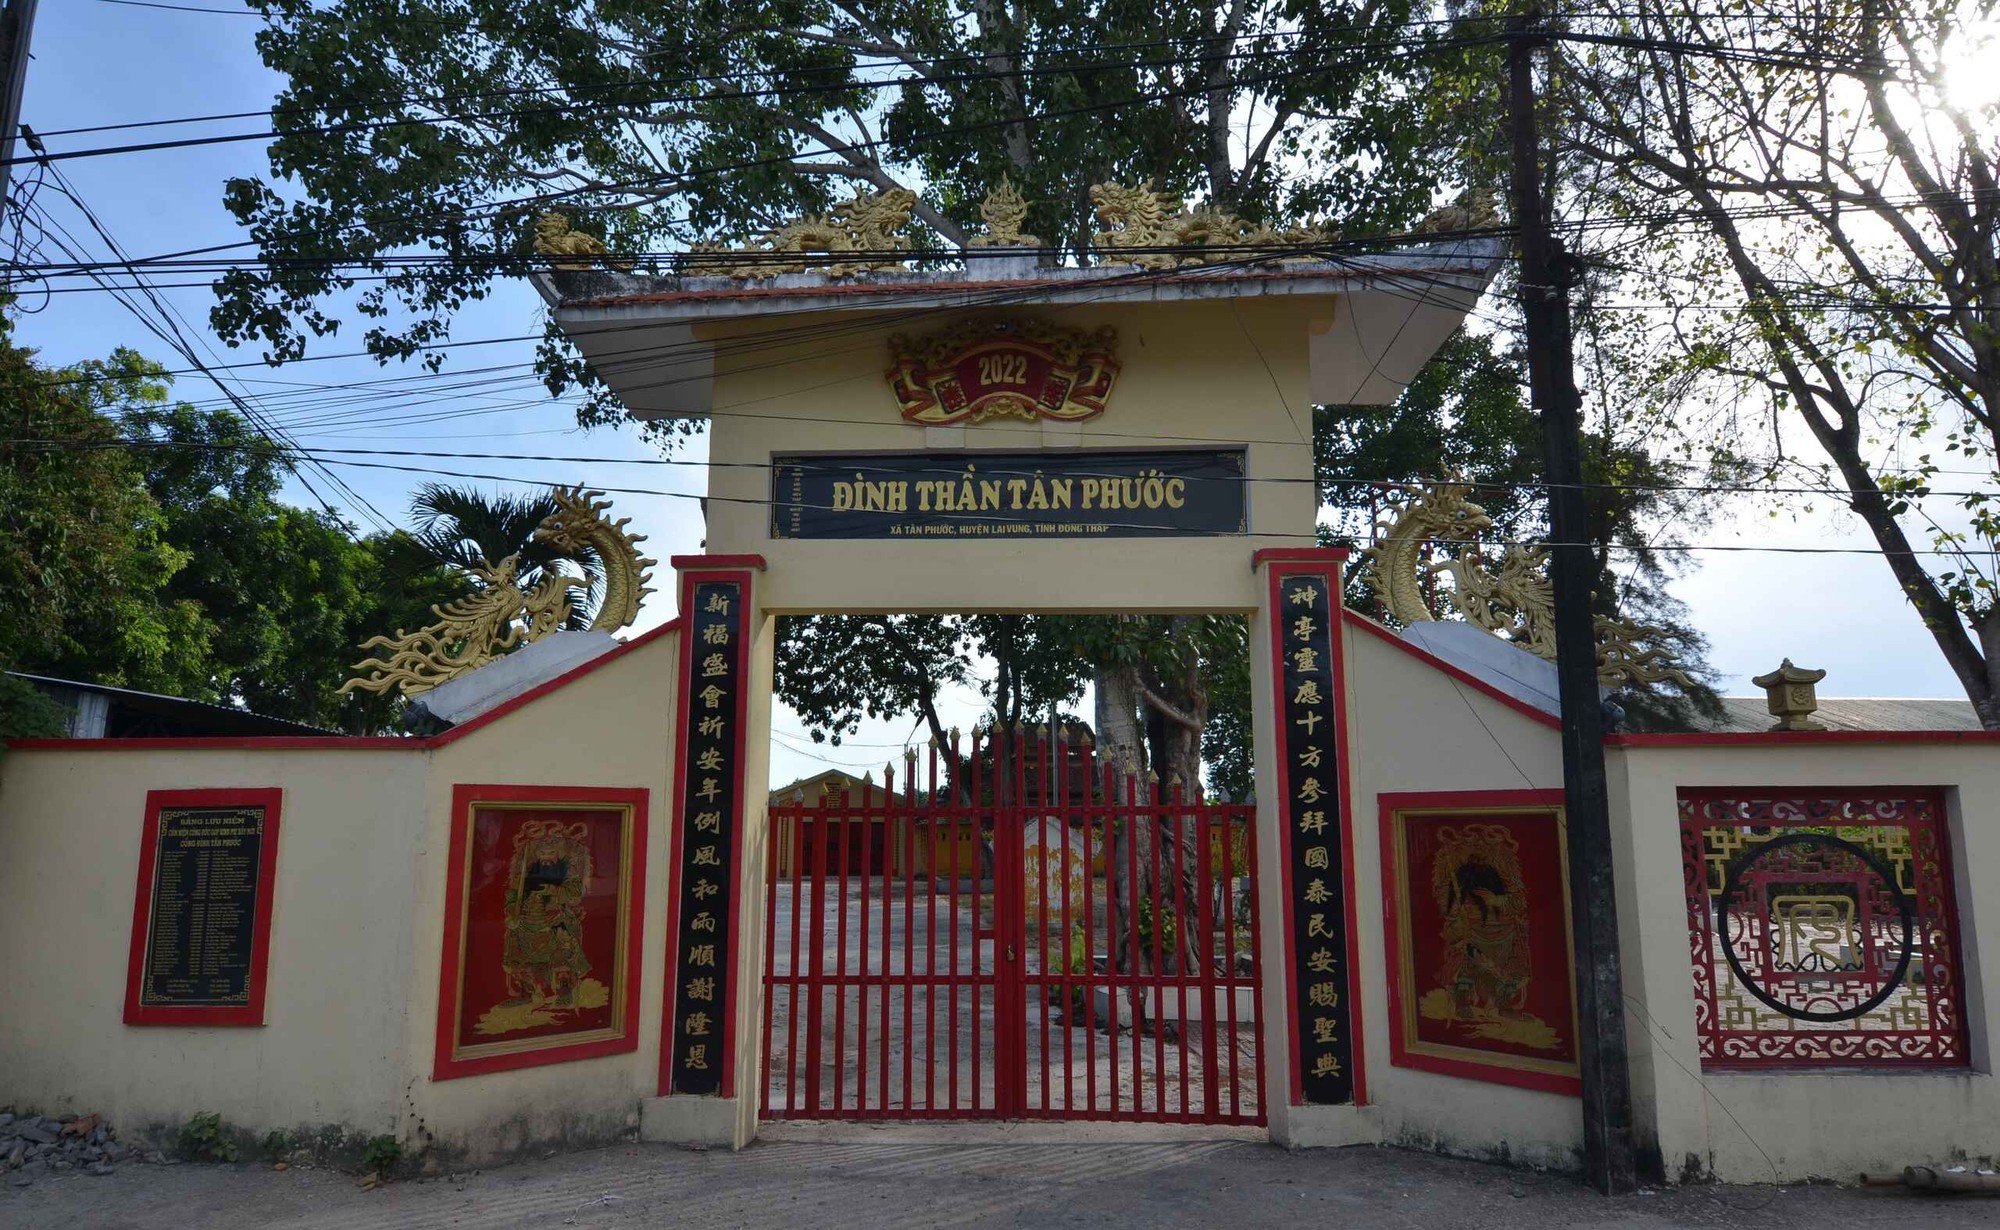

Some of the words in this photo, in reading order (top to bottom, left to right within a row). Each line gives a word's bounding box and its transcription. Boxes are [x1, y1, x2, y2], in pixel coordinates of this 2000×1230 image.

[978, 354, 1028, 386] 2022
[832, 472, 909, 512] ĐÌNH
[915, 463, 1002, 512] THẦN
[1007, 470, 1072, 510] TÂN
[1081, 469, 1185, 509] PHƯỚC
[890, 523, 903, 535] XÃ
[904, 523, 923, 535] TÂN
[924, 523, 957, 535] PHƯỚC,
[959, 522, 989, 535] HUYỆN
[1035, 521, 1057, 533] TỈNH
